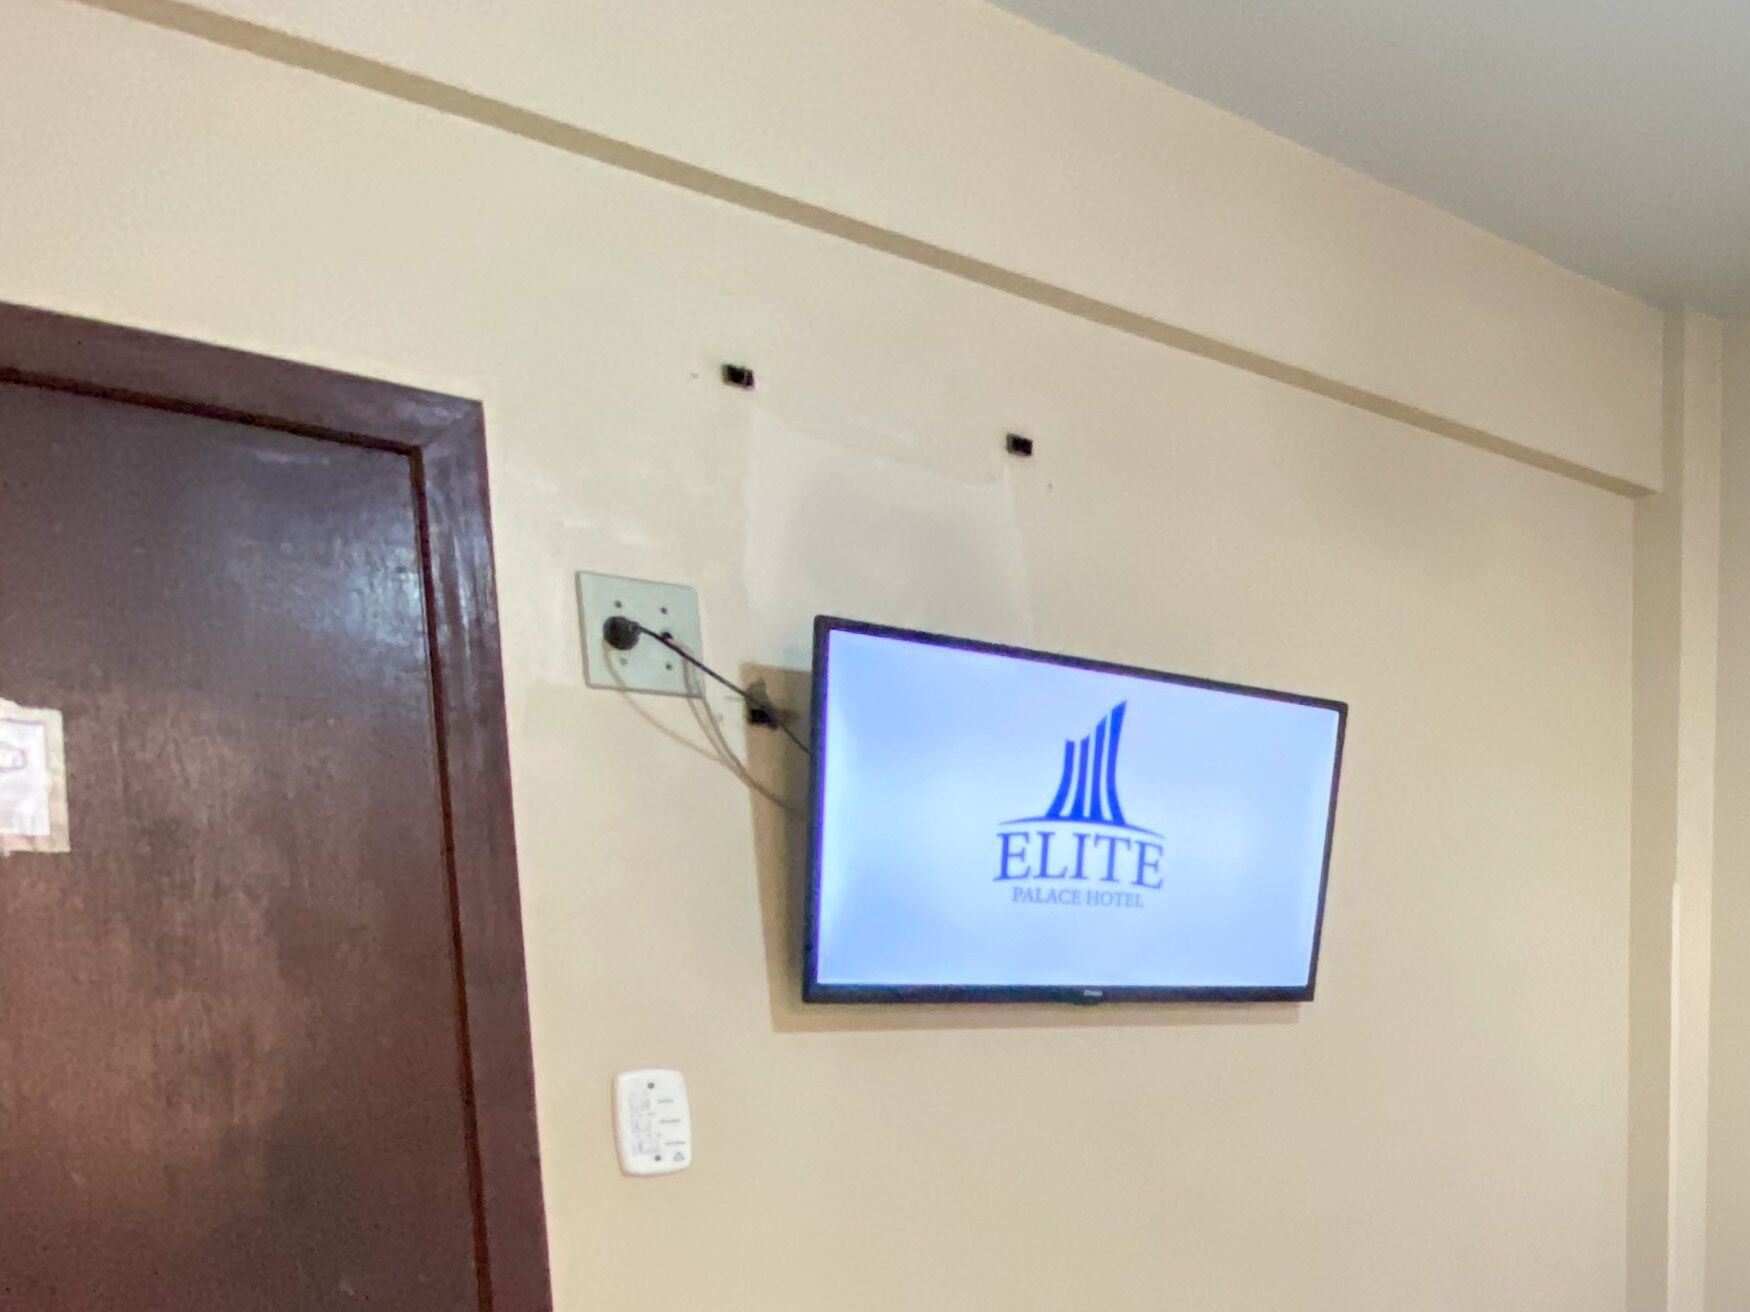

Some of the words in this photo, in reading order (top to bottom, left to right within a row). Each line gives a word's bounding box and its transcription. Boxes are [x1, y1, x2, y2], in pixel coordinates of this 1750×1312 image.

[992, 831, 1165, 889] ELITE
[1012, 886, 1081, 905] PALACE
[1086, 889, 1144, 908] HOTEL
